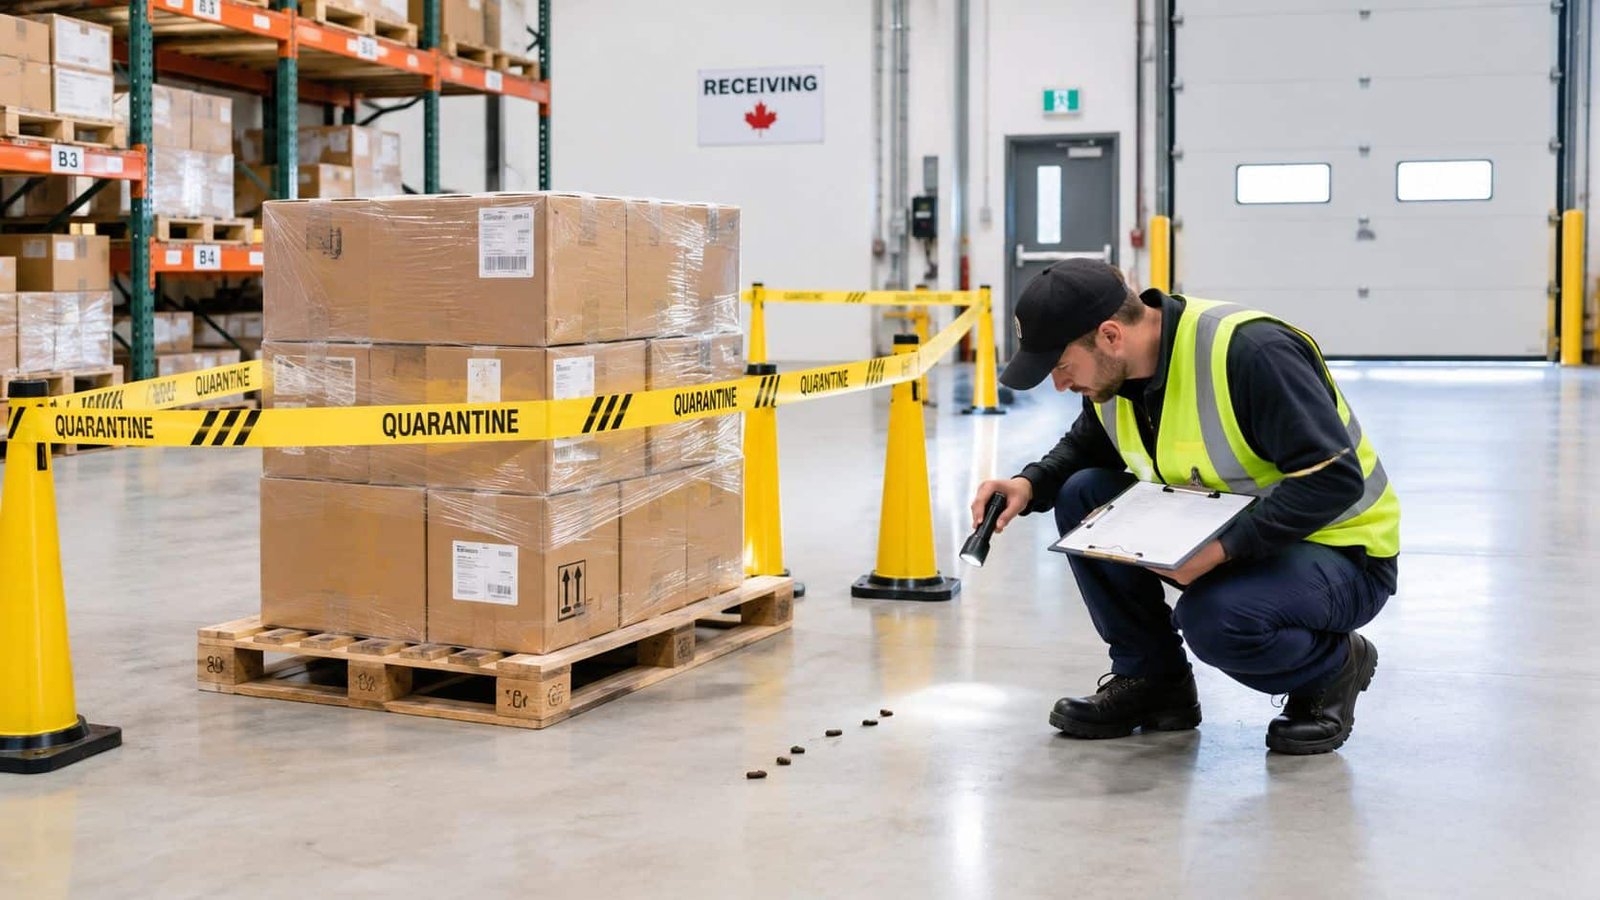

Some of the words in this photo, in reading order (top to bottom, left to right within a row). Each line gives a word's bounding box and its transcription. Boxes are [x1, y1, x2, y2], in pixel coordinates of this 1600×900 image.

[703, 75, 818, 95] RECEIVING
[58, 151, 78, 168] B3
[200, 249, 215, 266] B4
[674, 386, 737, 416] QUARANTINE
[55, 414, 154, 439] QUARANTINE
[382, 408, 519, 439] QUARANTINE
